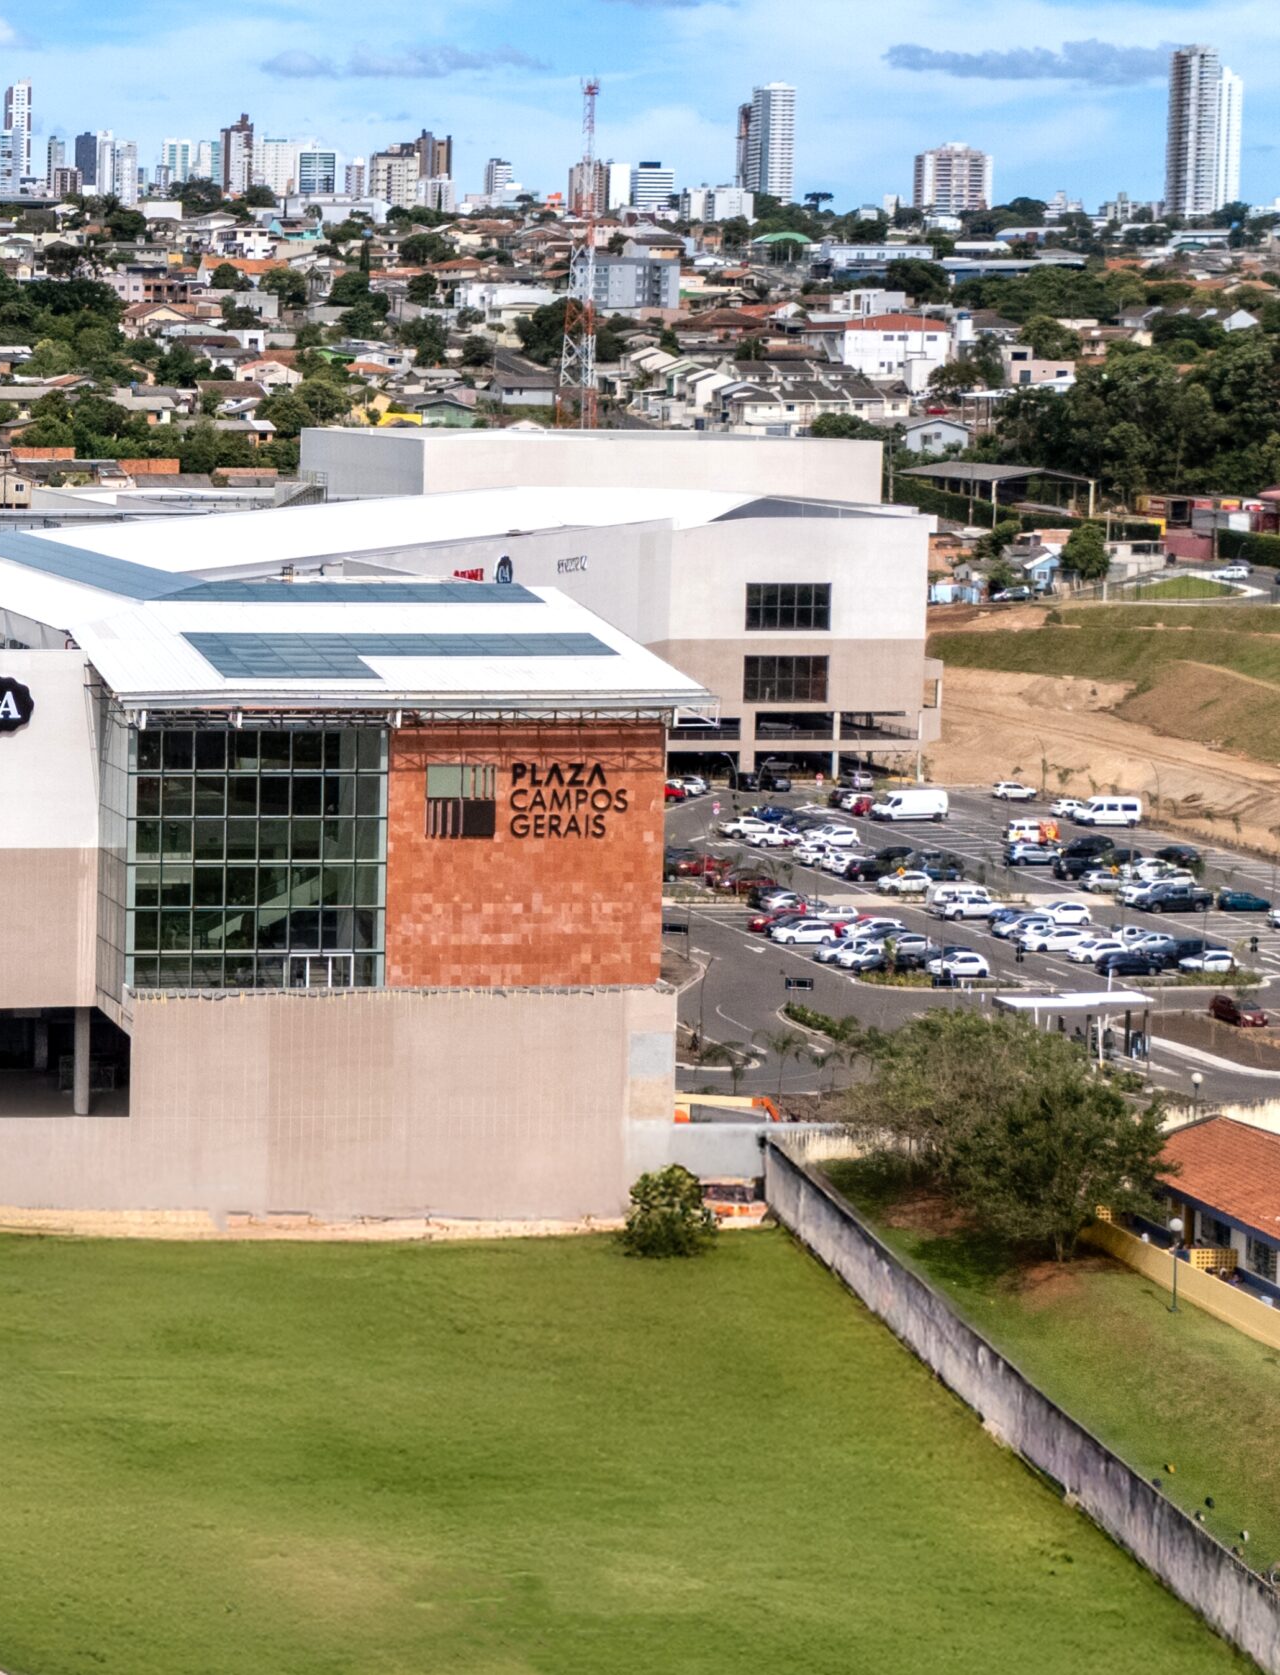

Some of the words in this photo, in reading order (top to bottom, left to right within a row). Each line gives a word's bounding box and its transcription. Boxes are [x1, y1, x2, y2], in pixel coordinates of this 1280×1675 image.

[511, 762, 608, 787] PLAZA
[509, 788, 629, 814] CAMPOS
[509, 814, 607, 839] GERAIS
